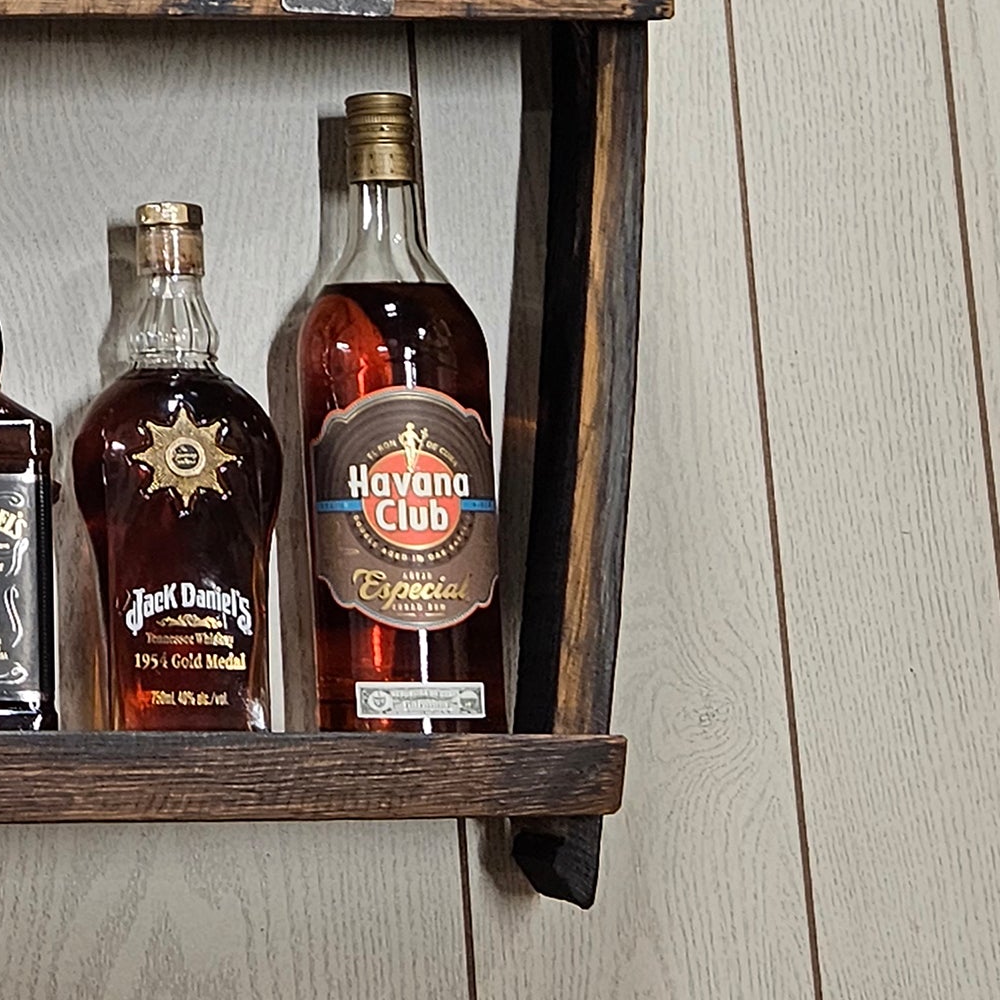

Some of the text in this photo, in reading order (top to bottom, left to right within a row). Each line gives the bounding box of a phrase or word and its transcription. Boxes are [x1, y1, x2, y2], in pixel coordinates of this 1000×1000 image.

[348, 464, 470, 498] Havana
[376, 498, 449, 531] Club
[381, 547, 408, 561] AGED
[353, 568, 470, 611] Especial
[126, 582, 253, 636] Jack Daniel's
[171, 652, 203, 669] Gold
[205, 651, 247, 670] Medal
